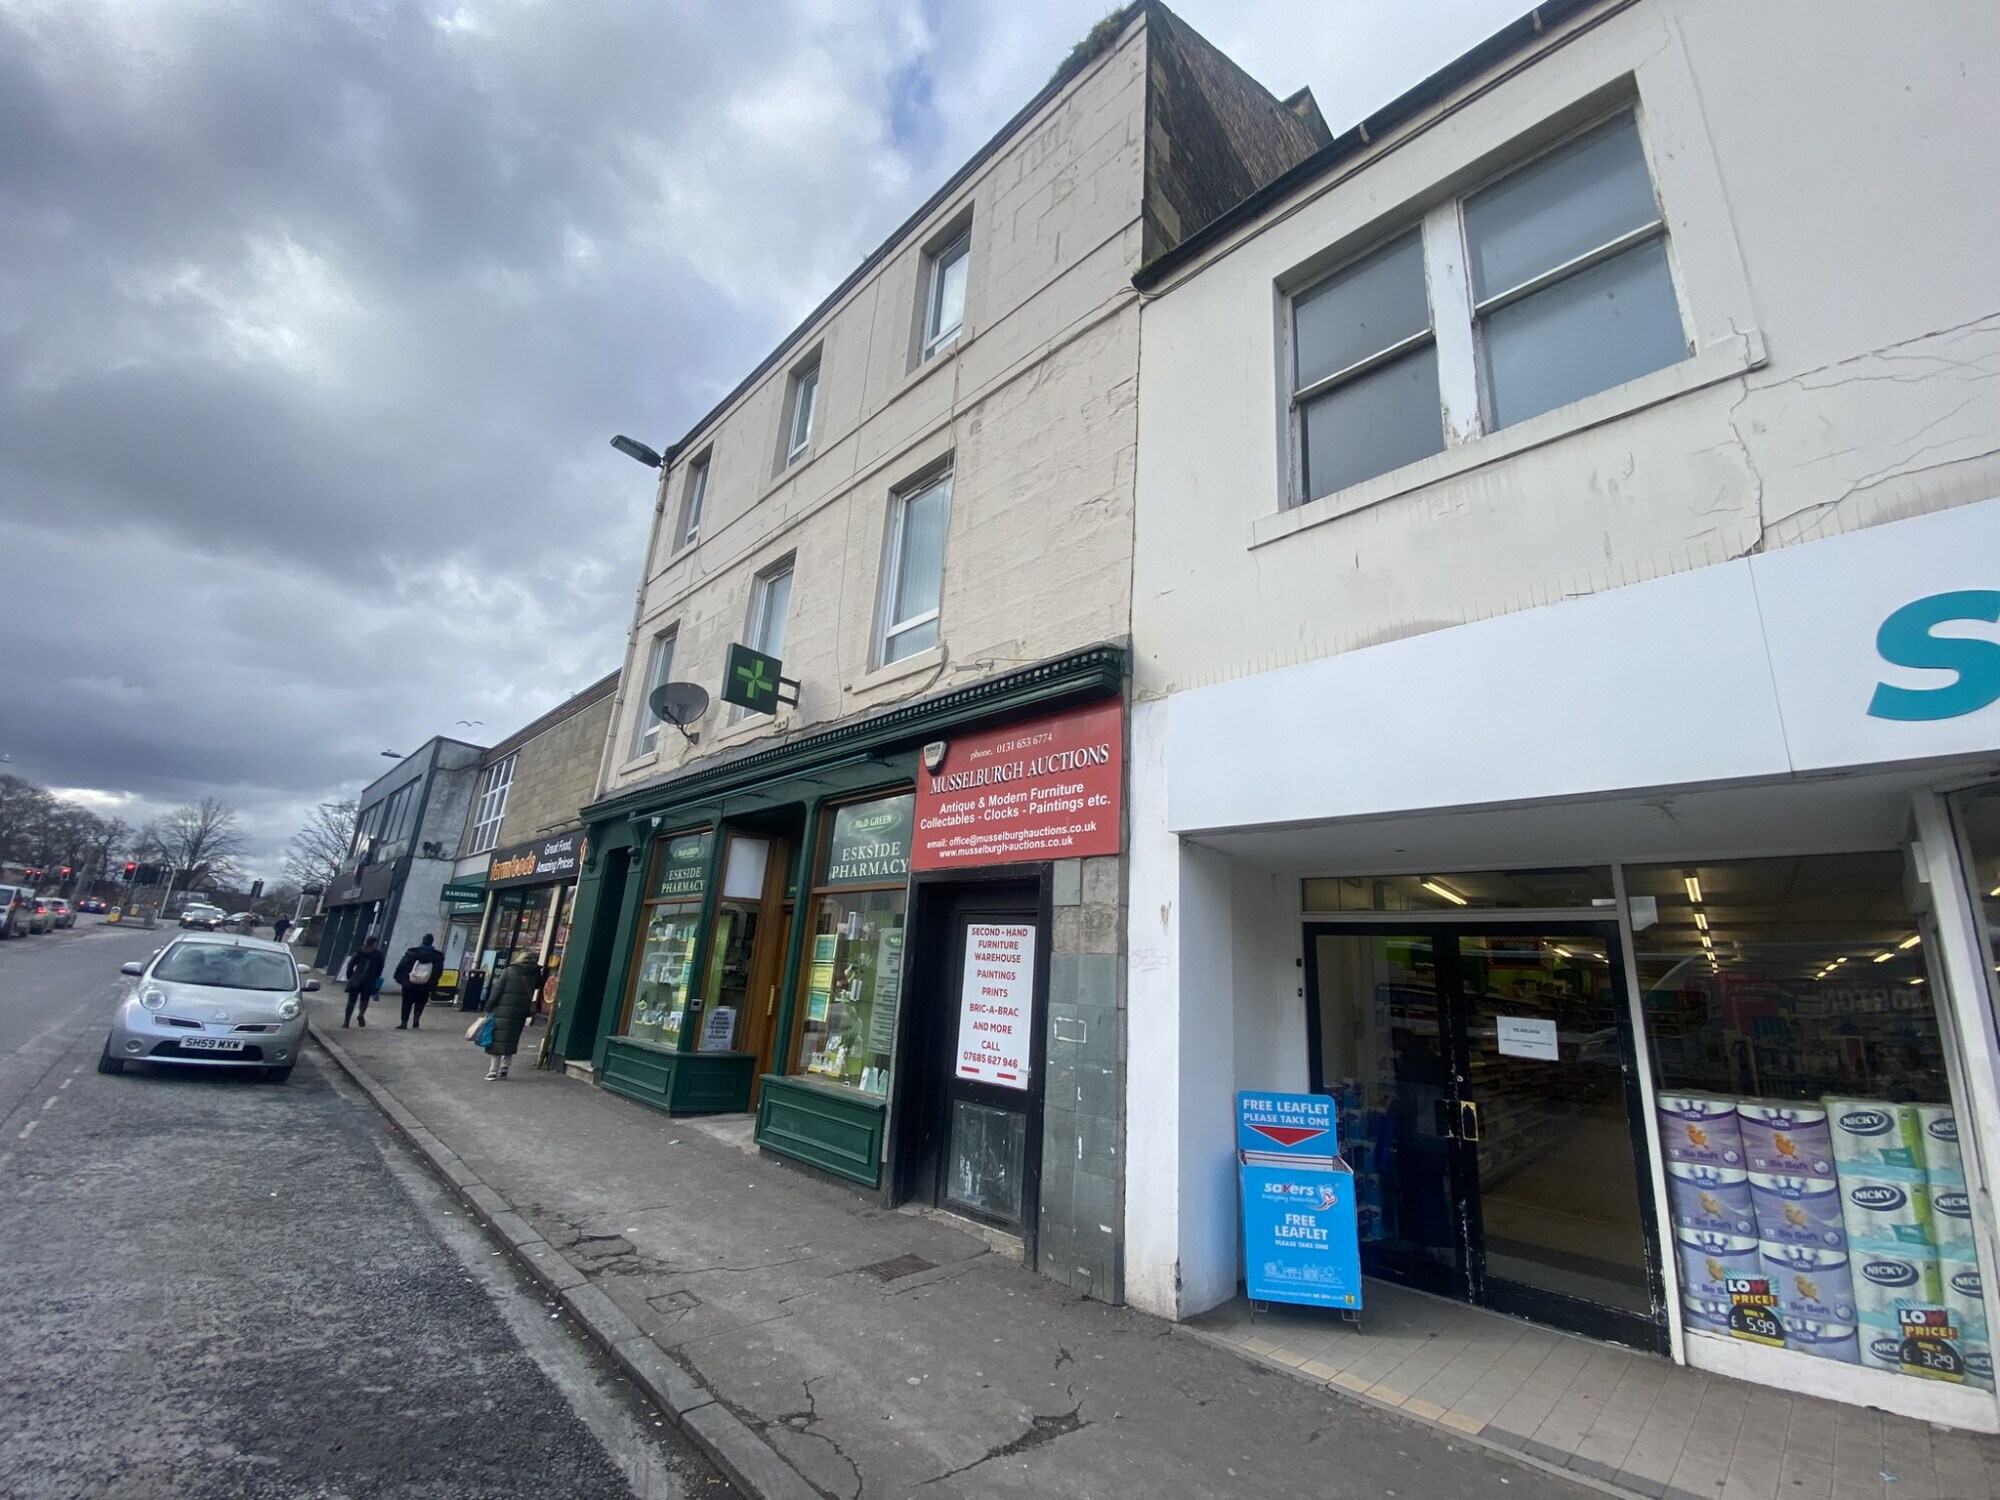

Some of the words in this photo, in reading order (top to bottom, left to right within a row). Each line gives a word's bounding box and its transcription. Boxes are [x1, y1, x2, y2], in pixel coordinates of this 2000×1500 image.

[996, 739, 1015, 754] 0131
[1016, 736, 1031, 749] 653
[1033, 732, 1053, 747] 6774
[930, 762, 1024, 795] MUSSELBURGH
[1027, 743, 1109, 778] AUCTIONS
[939, 798, 976, 815] Antique
[978, 796, 986, 808] &
[988, 791, 1027, 808] Modern
[1030, 782, 1084, 801] Furniture
[920, 811, 975, 830] Collectables
[984, 807, 1019, 822] Clocks
[1029, 798, 1084, 816] Paintings
[1088, 792, 1111, 808] etc.
[870, 814, 893, 827] GREEN
[927, 838, 948, 849] email:
[949, 820, 1097, 847] office@musselburghauctions.co.uk
[544, 839, 559, 855] Great
[841, 841, 901, 862] ESKSIDE
[939, 835, 1073, 858] www.musselburgh-auctions.co.uk
[536, 859, 557, 874] Amazing
[557, 855, 575, 870] Prices
[831, 858, 910, 879] PHARMACY
[669, 866, 702, 881] ESKSIDE
[661, 879, 706, 894] PHARMACY
[971, 927, 1000, 937] SECOND
[1006, 928, 1028, 937] HAND
[978, 940, 1019, 950] FURNITURE
[975, 952, 1021, 963] WAREHOUSE
[976, 969, 1016, 981] PAINTINGS
[981, 986, 1008, 998] PRINTS
[969, 1003, 1019, 1017] BRIC-A-BRAC
[972, 1021, 989, 1032] AND
[989, 1023, 1013, 1035] MORE
[186, 1037, 216, 1049] SH59
[217, 1039, 241, 1050] MXW
[981, 1040, 1000, 1052] CALL
[986, 1054, 1002, 1066] 627
[1002, 1057, 1018, 1069] 946
[1243, 1098, 1273, 1112] FREE
[1277, 1101, 1330, 1115] LEAFLET
[1243, 1112, 1278, 1123] PLEASE
[1280, 1115, 1305, 1125] TAKE
[1308, 1117, 1330, 1127] ONE
[1842, 1114, 1879, 1126] NICKY
[1931, 1120, 1958, 1132] NIC
[1682, 1151, 1696, 1159] So
[1699, 1151, 1719, 1160] Soft
[1769, 1159, 1783, 1168] So
[1785, 1160, 1808, 1170] Soft
[1264, 1181, 1315, 1197] savers
[1854, 1188, 1891, 1200] NICKY
[1938, 1196, 1969, 1207] NICK
[1285, 1213, 1316, 1227] FREE
[1694, 1217, 1709, 1227] So
[1275, 1225, 1328, 1241] LEAFLET
[1777, 1229, 1793, 1239] So
[1275, 1239, 1297, 1248] PLEASE
[1298, 1241, 1313, 1250] TAKE
[1315, 1243, 1329, 1251] ONE
[1866, 1264, 1905, 1277] NICKY
[1728, 1279, 1765, 1294] LOW
[1954, 1275, 1981, 1287] NIC
[1732, 1294, 1774, 1306] PRICE!
[1743, 1309, 1765, 1319] ONLY
[1900, 1309, 1946, 1325] LOW
[1746, 1316, 1776, 1336] 5.99
[1905, 1325, 1953, 1339] PRICE!
[1922, 1350, 1954, 1370] 3.29
[1965, 1356, 1991, 1367] NIC
